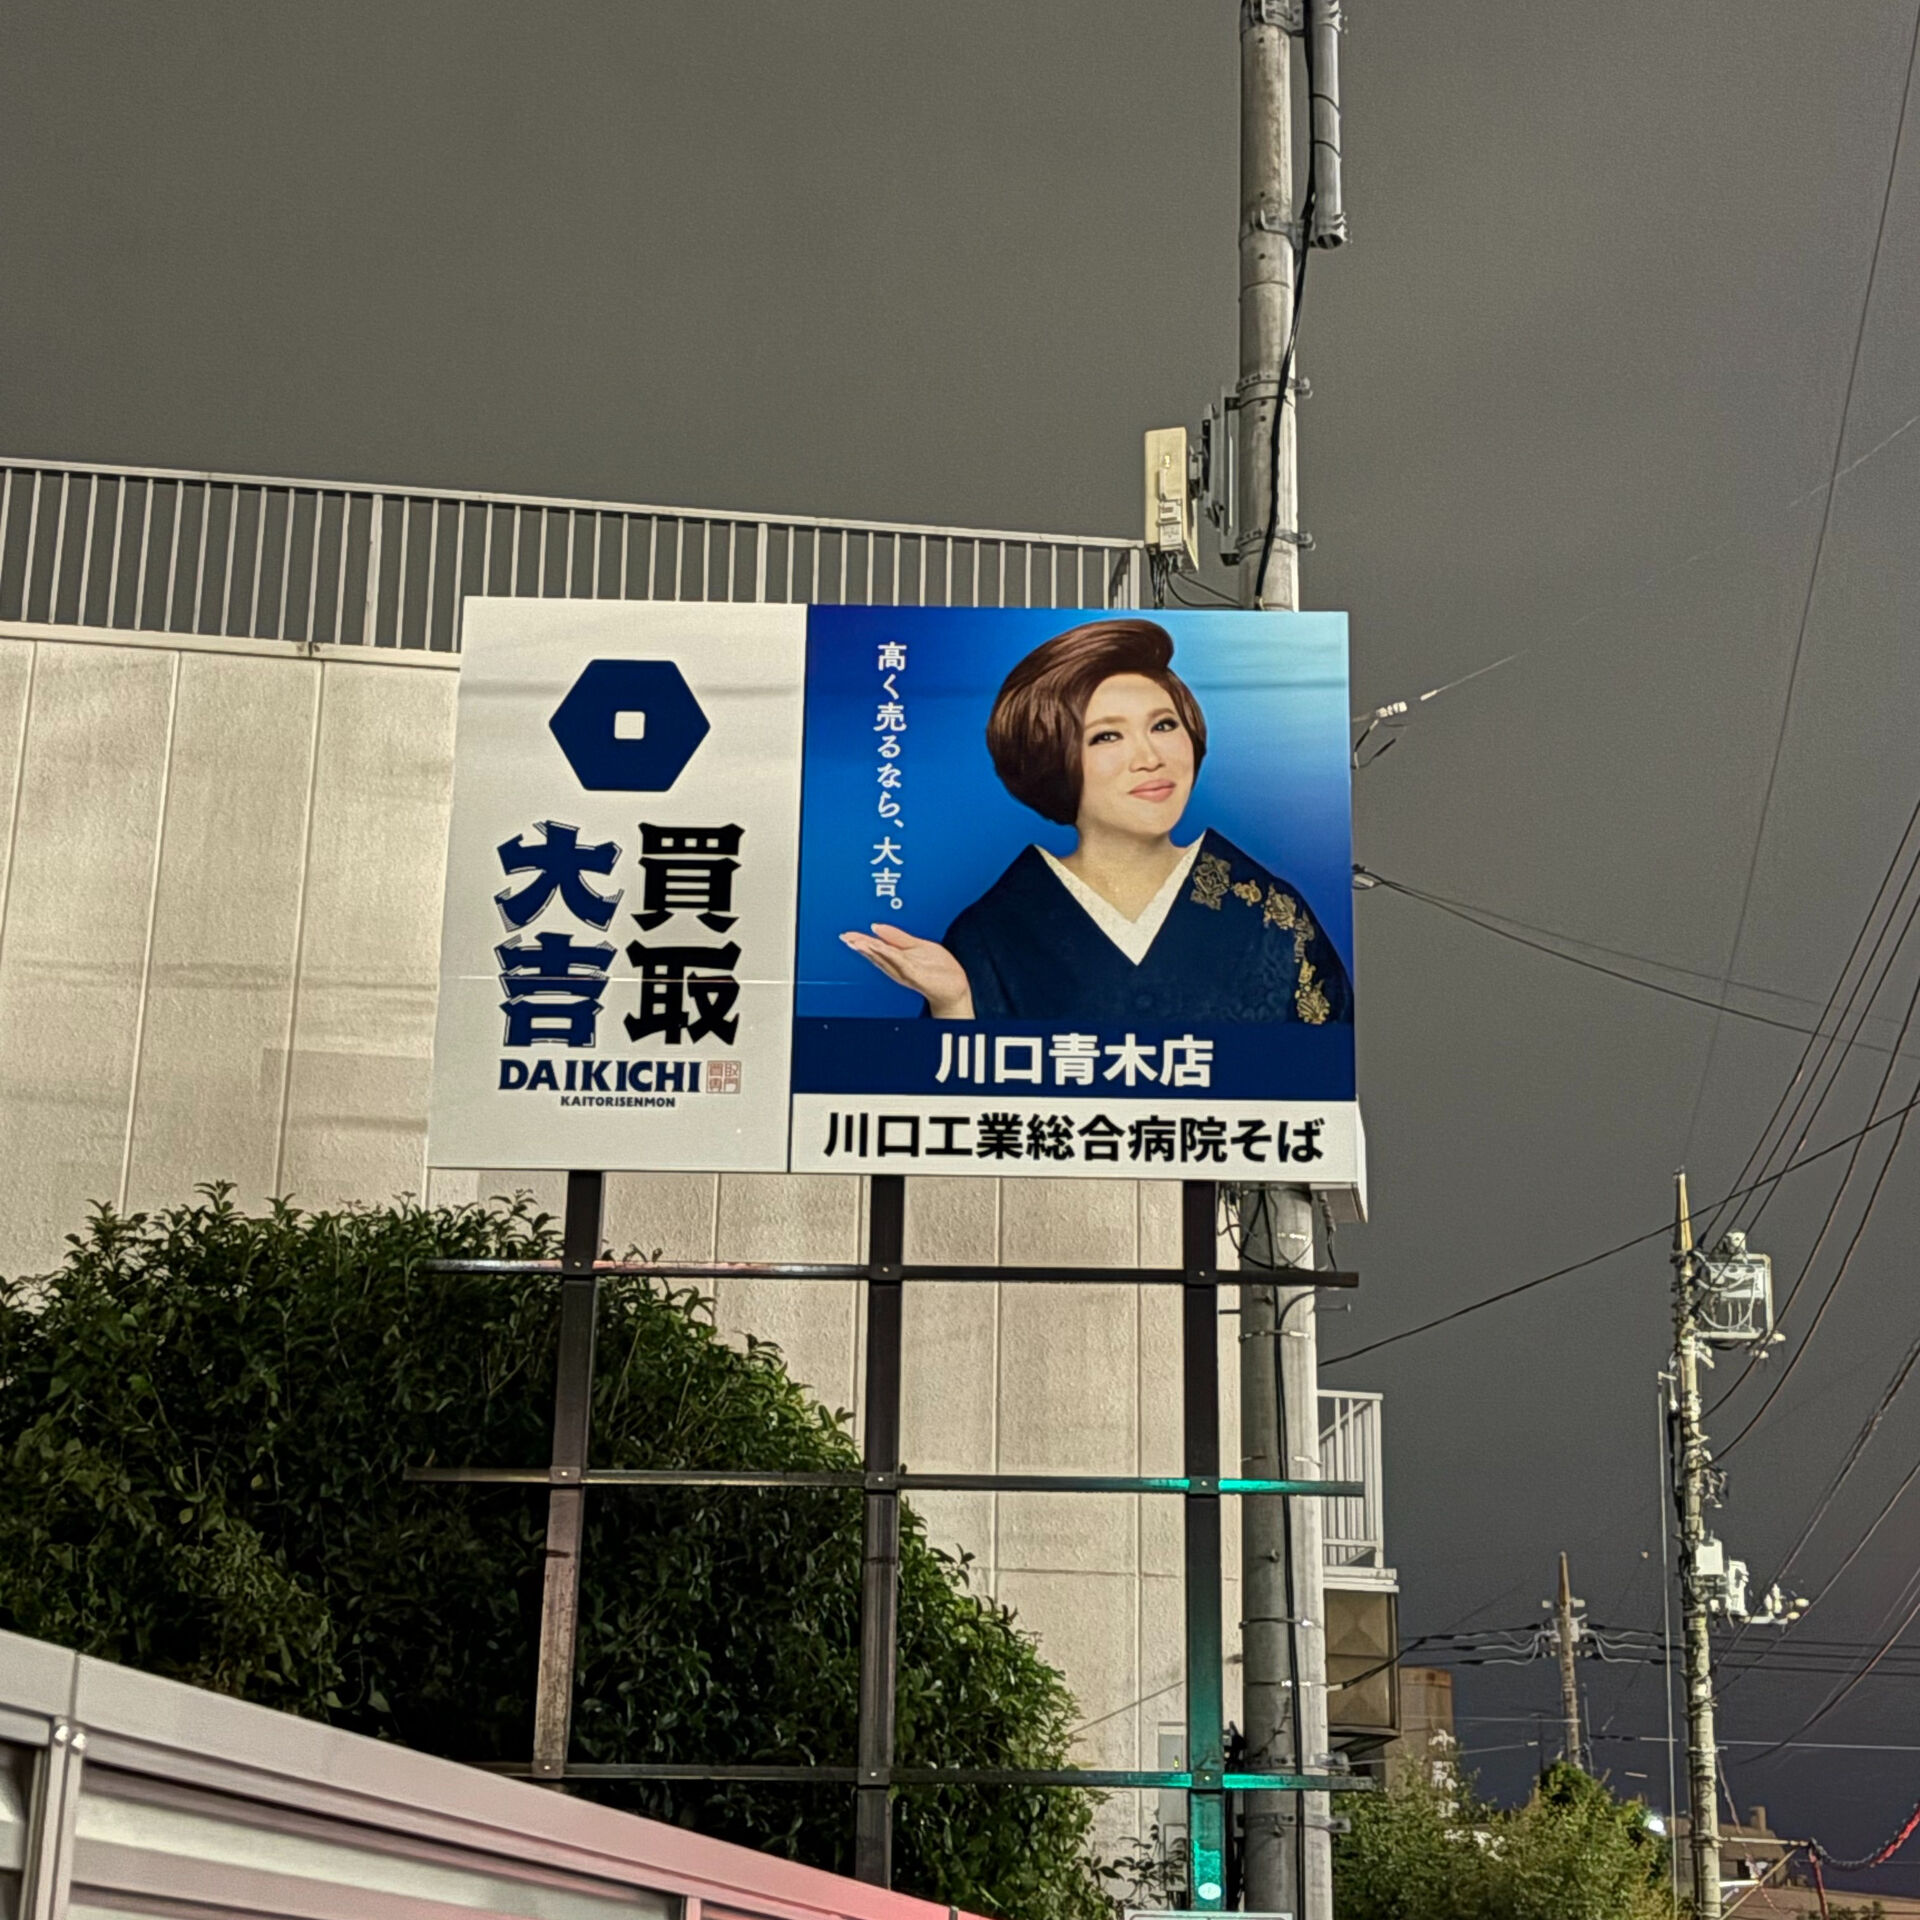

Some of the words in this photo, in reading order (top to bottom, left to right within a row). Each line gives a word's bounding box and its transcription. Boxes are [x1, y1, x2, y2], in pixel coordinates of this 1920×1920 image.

[870, 641, 907, 910] 高く売るなら、大吉。
[494, 820, 624, 1047] 大吉
[624, 823, 745, 1045] 買取
[498, 1059, 702, 1093] DAIKICHI
[935, 1033, 1214, 1088] 川口青木店
[560, 1096, 676, 1108] KAITORISENMON
[823, 1112, 1326, 1163] 川口工業総合病院そば
